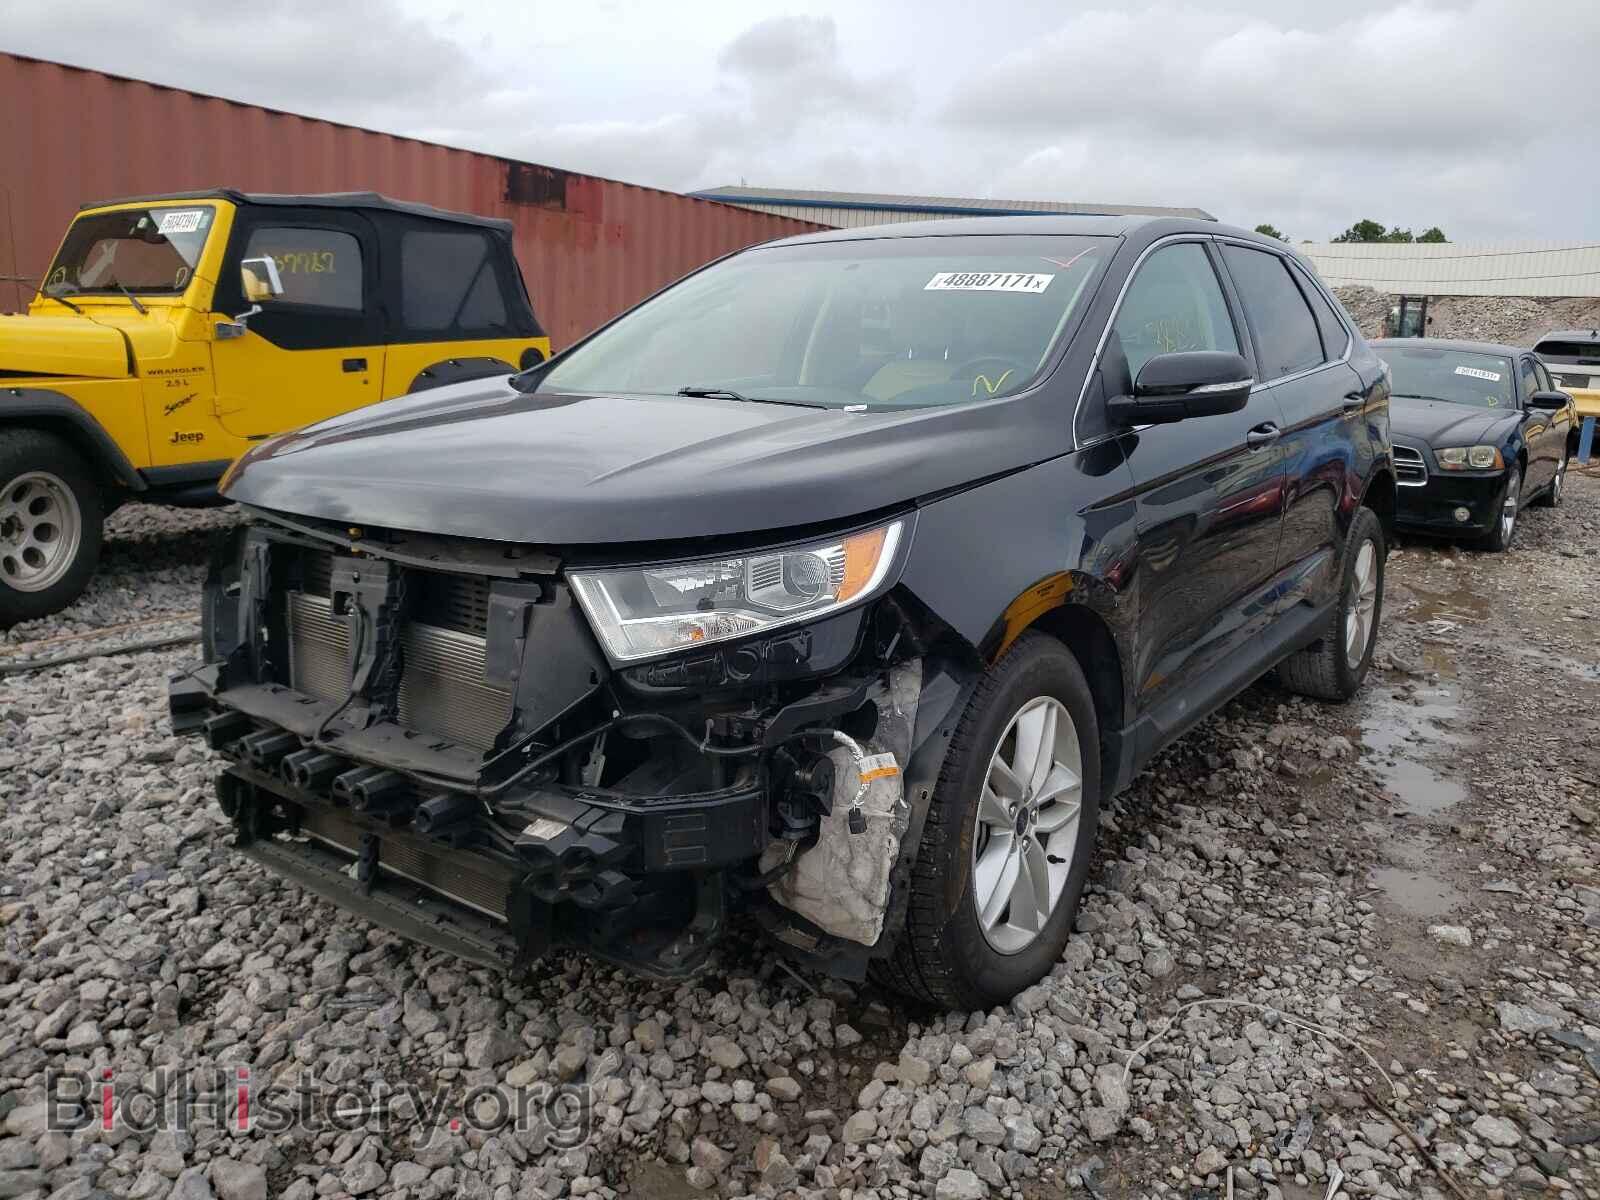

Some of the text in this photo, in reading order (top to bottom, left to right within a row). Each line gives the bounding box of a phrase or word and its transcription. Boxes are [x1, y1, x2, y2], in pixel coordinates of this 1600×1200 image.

[147, 366, 206, 376] WRANGLER
[165, 378, 190, 388] 2.5 L
[170, 431, 204, 444] Jeep
